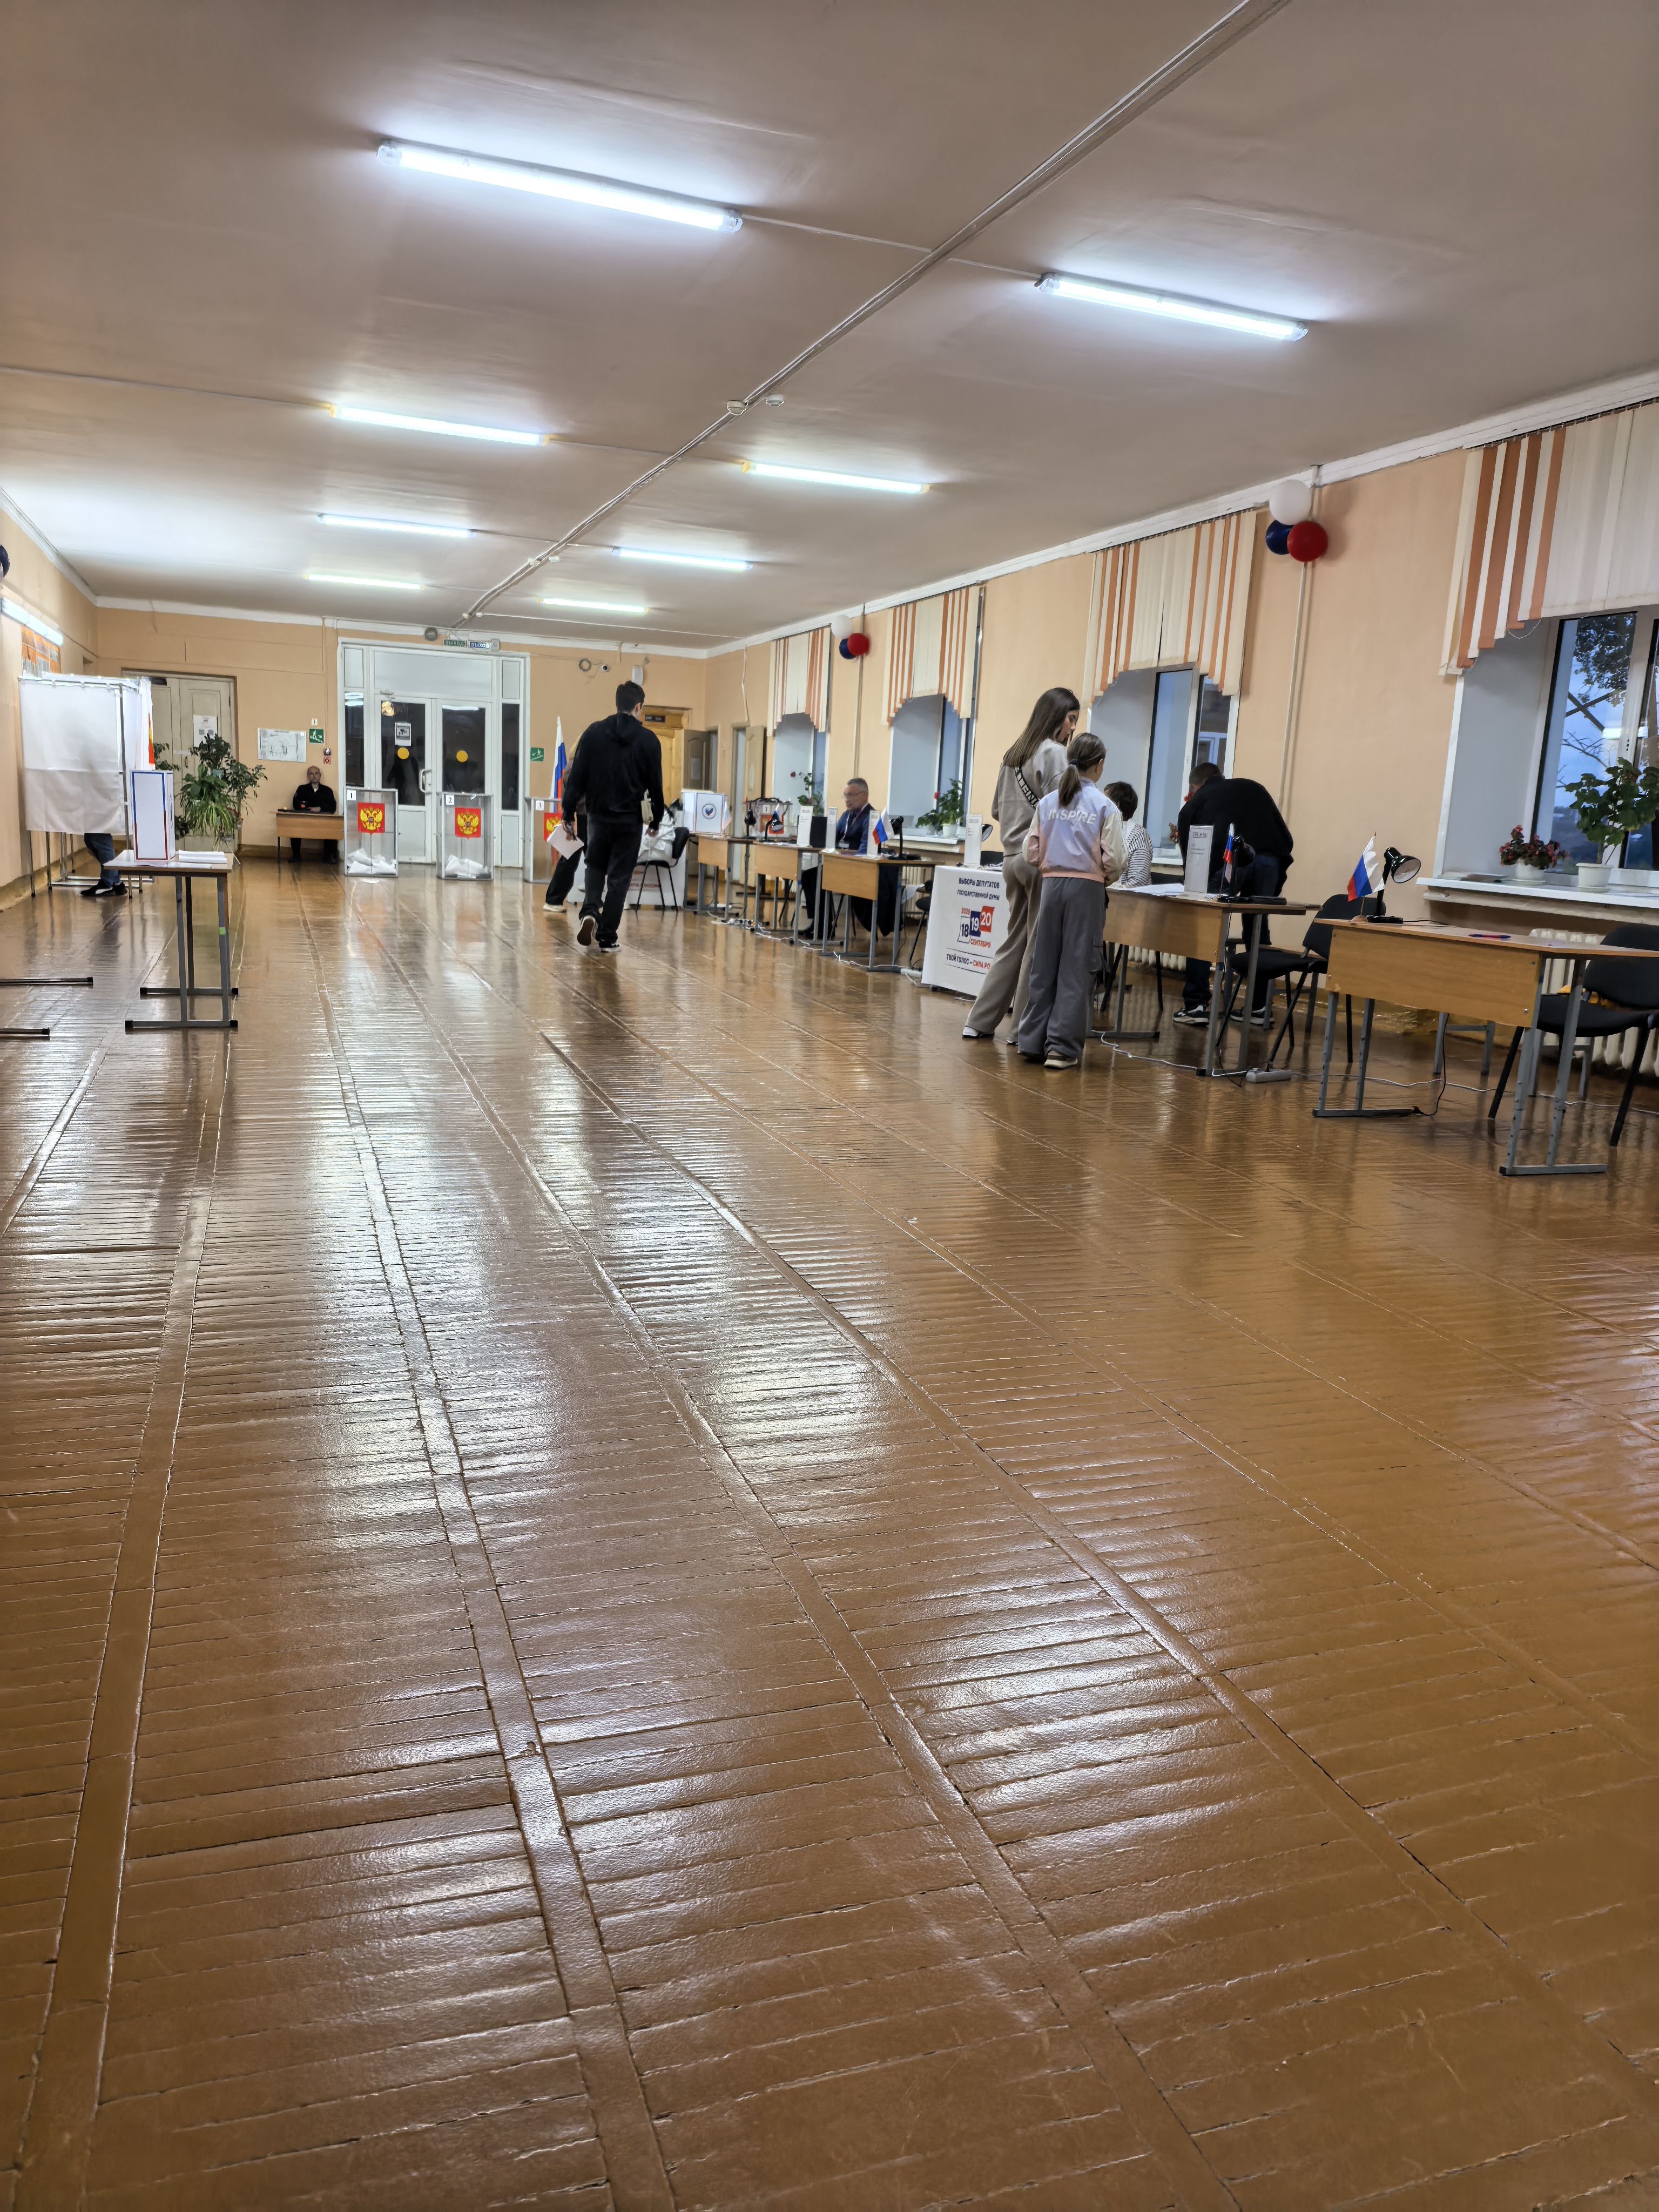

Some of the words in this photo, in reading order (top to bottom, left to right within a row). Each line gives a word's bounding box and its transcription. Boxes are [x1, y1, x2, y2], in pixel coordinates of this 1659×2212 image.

[1048, 808, 1097, 825] INSPIRE
[959, 878, 975, 886] ВЫБОРЫ
[976, 880, 1000, 888] ДЕПУТАТОВ
[957, 889, 989, 899] ГОСУДАРСТВЕННОЙ
[961, 923, 969, 938] 18
[971, 917, 979, 931] 19
[981, 912, 992, 926] 20
[970, 939, 991, 948] СЕНТЯБРЯ
[946, 954, 956, 962] ТВОЙ
[956, 956, 969, 965] ГОЛОС
[973, 960, 983, 968] СИЛА
